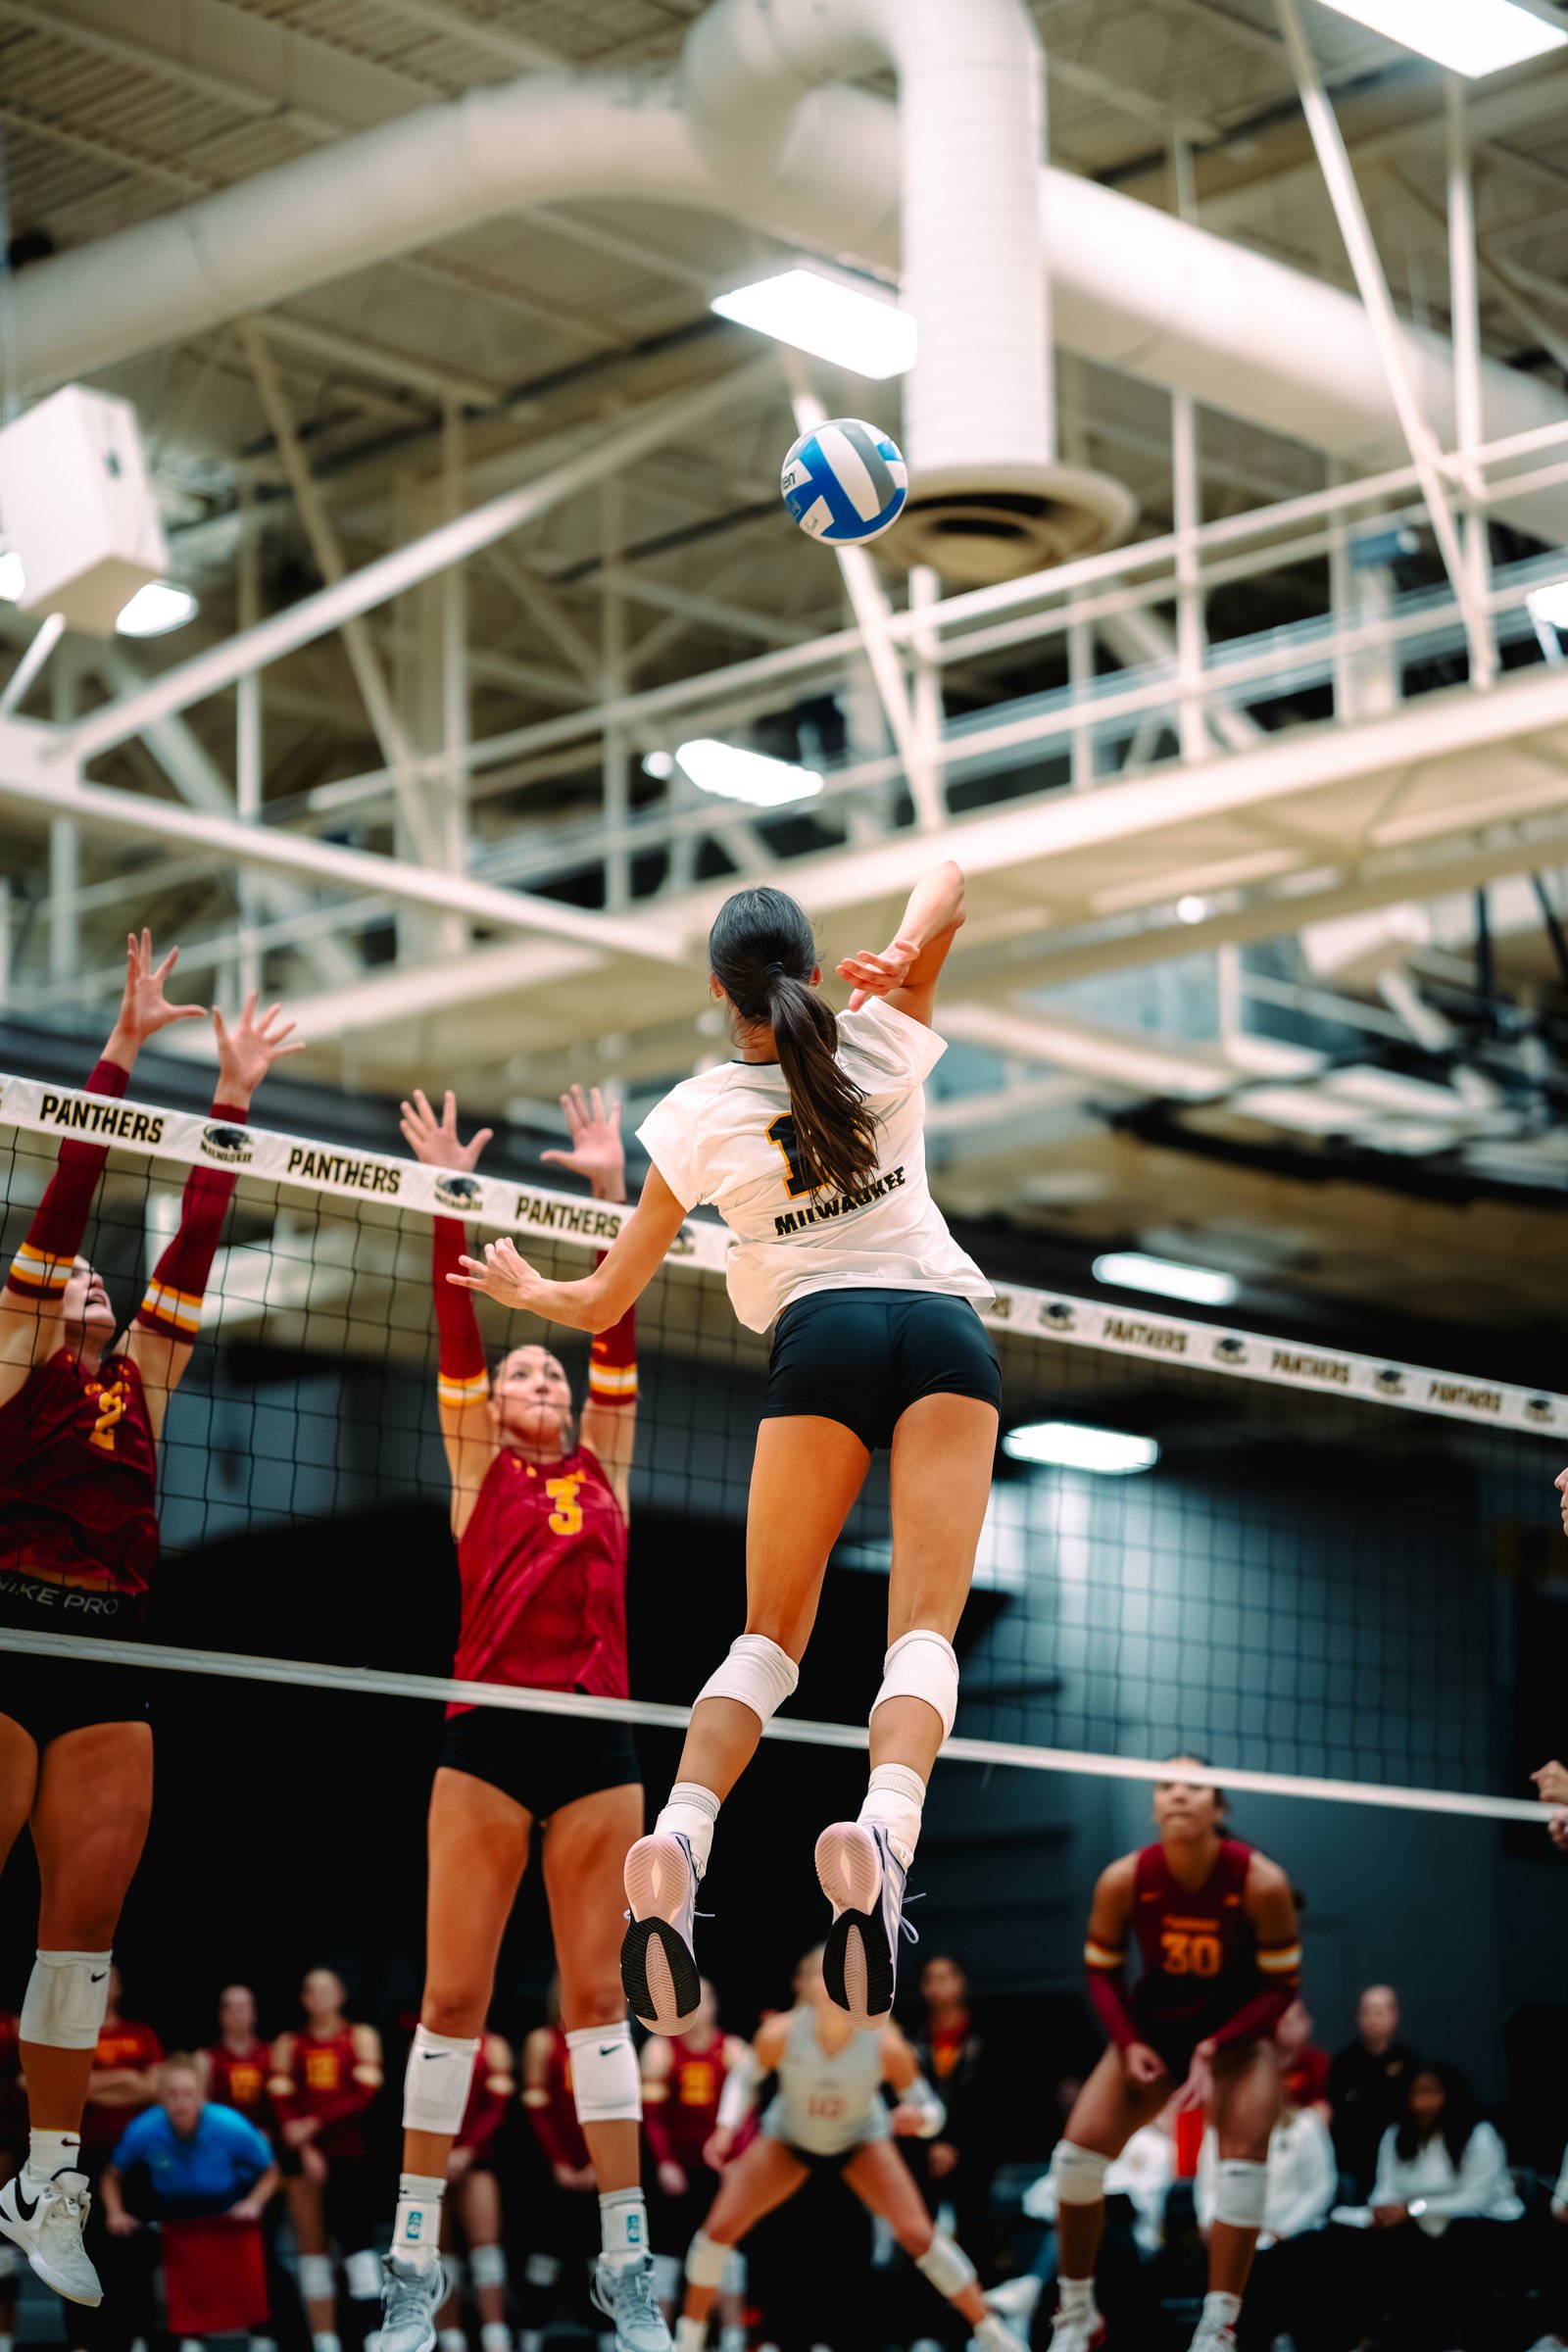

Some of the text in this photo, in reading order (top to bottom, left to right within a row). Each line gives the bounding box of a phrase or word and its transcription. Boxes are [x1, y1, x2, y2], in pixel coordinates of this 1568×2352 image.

[39, 1094, 165, 1145] PANTHERS
[286, 1148, 402, 1195] PANTHERS
[514, 1195, 622, 1240] PANTHERS
[774, 1166, 906, 1237] MILWAUKEE
[1102, 1316, 1189, 1354] PANTHERS
[88, 1392, 126, 1450] 2
[545, 1478, 583, 1536] 3
[64, 1593, 119, 1615] PRO
[1161, 1932, 1221, 1977] 30
